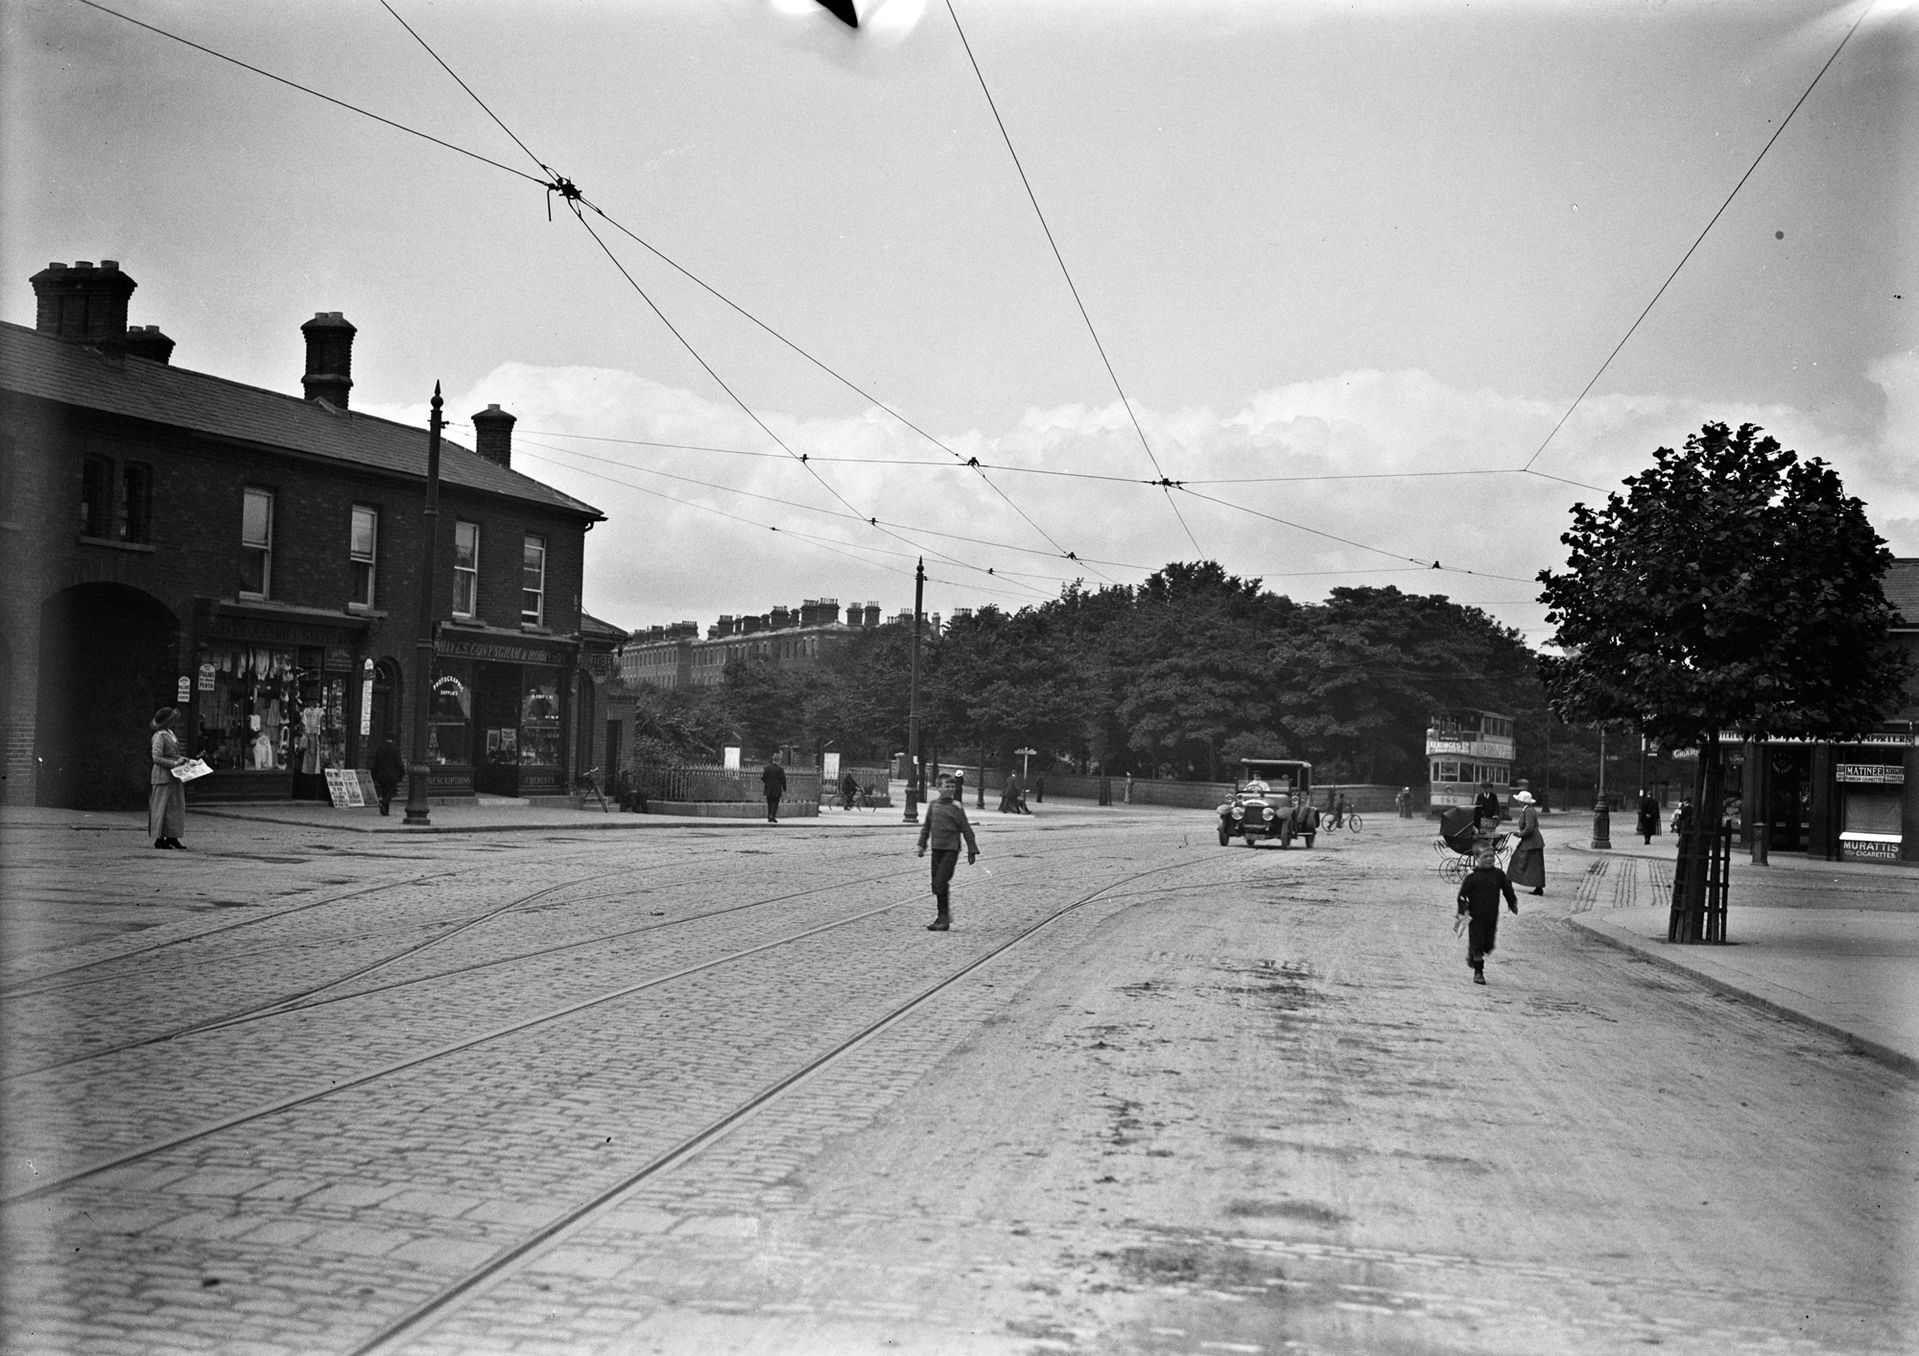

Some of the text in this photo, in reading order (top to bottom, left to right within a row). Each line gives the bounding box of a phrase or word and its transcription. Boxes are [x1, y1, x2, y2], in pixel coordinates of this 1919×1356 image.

[471, 643, 521, 660] CONYNGHAM
[433, 676, 464, 692] PHOTOGRAPHIC
[525, 776, 555, 785] CHEMISTS
[1856, 850, 1896, 858] CIGARETTES
